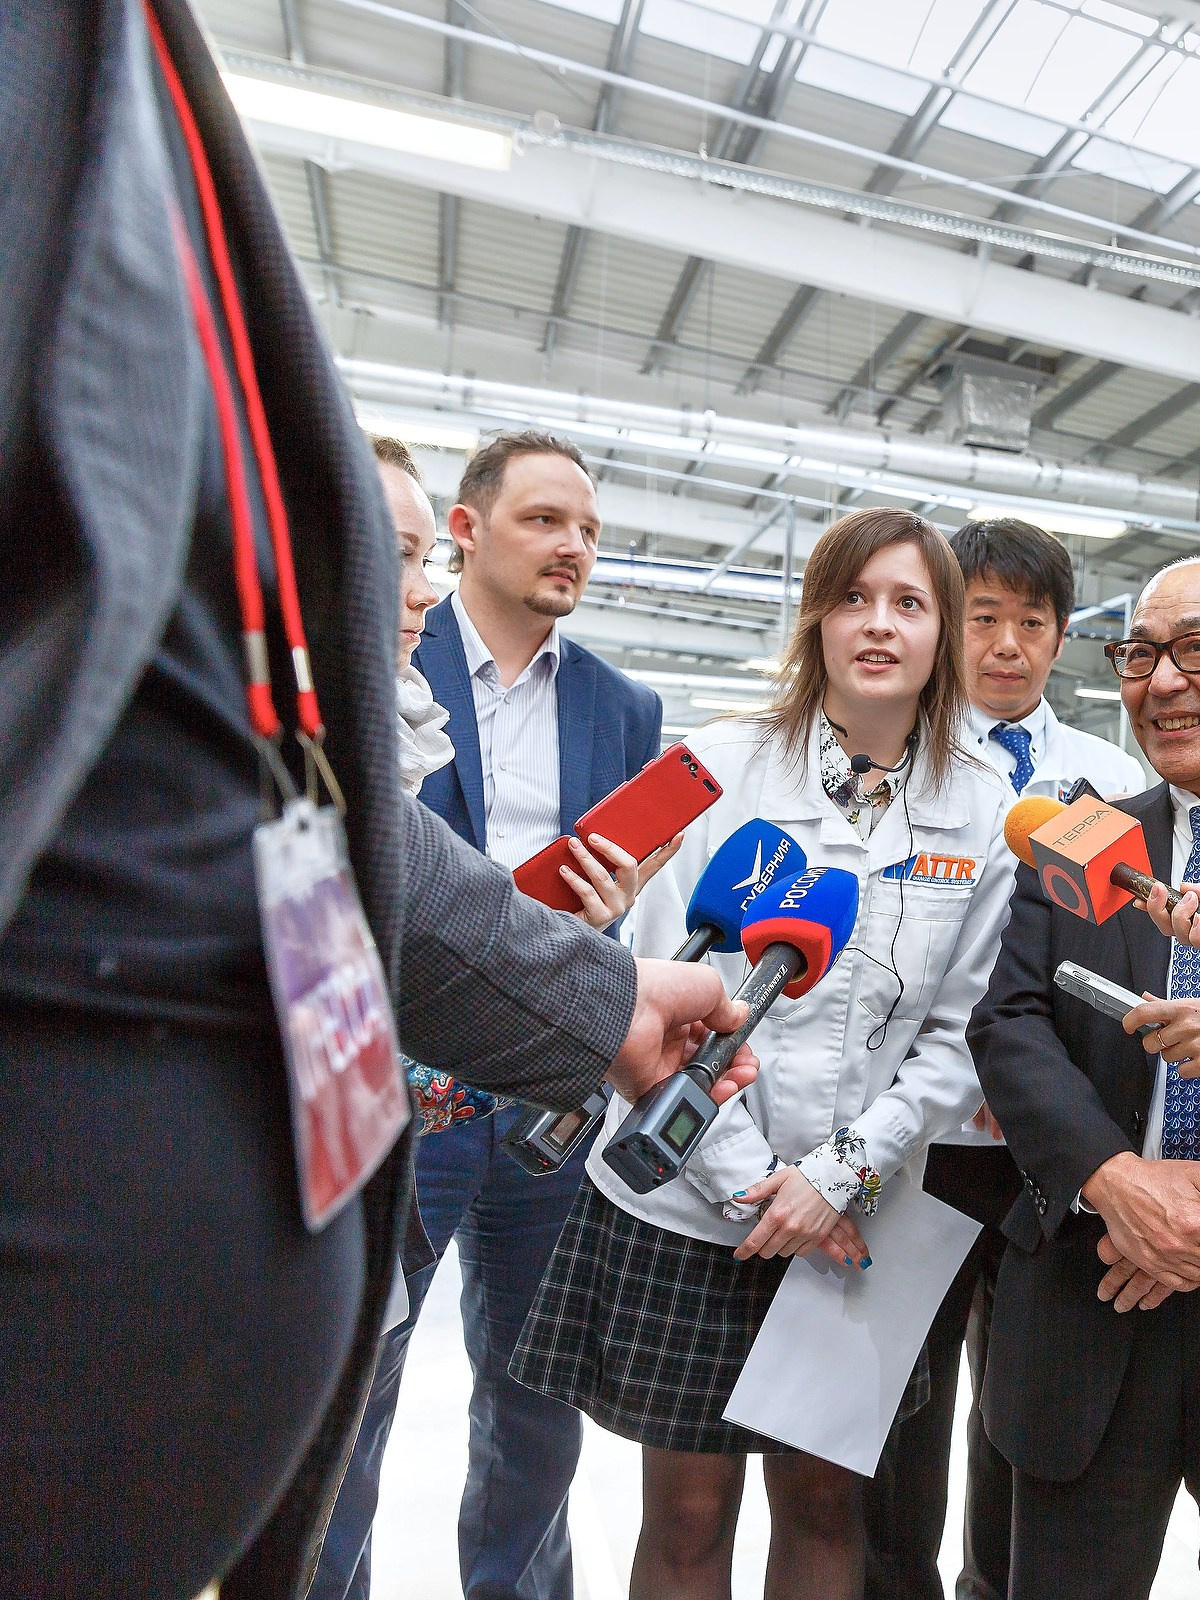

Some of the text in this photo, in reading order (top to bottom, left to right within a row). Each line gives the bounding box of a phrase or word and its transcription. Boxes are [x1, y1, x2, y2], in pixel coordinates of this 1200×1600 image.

[1052, 809, 1109, 846] ТЕРРА
[740, 837, 791, 912] ГУБЕРНИЯ
[912, 853, 976, 880] ATTR
